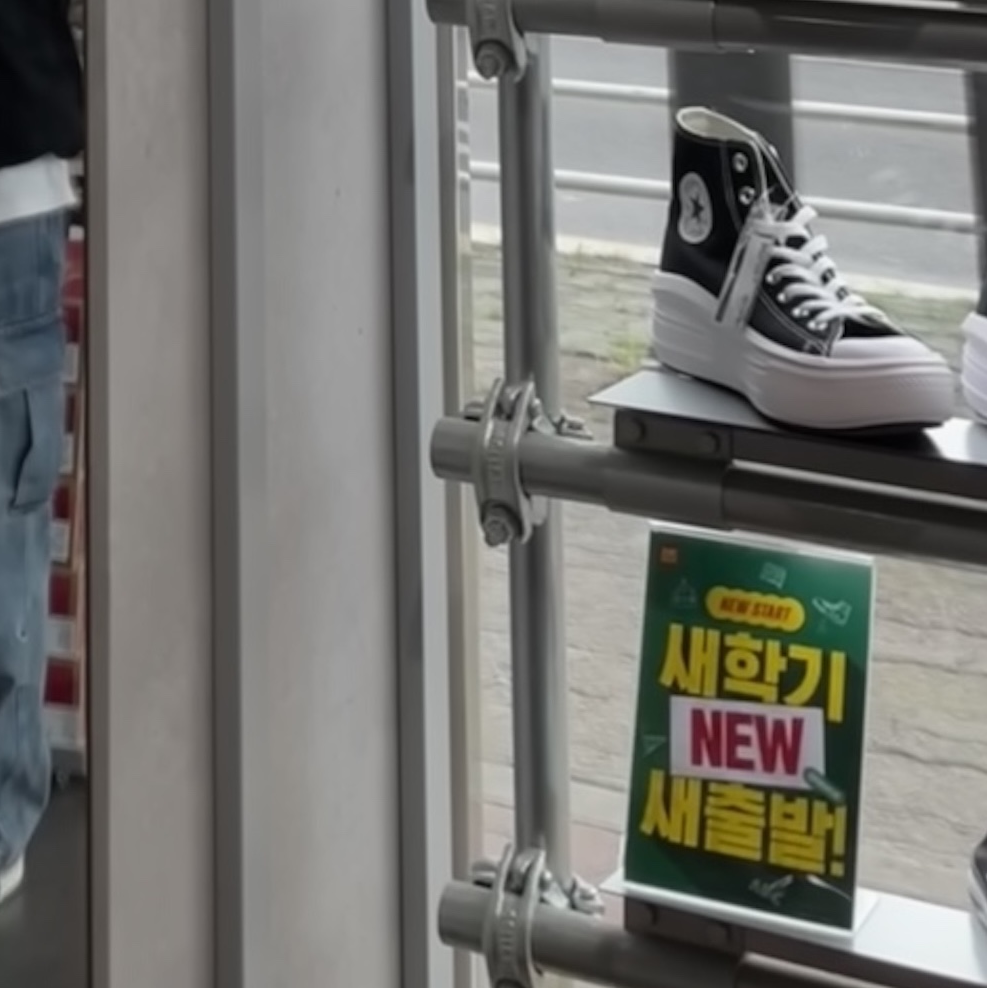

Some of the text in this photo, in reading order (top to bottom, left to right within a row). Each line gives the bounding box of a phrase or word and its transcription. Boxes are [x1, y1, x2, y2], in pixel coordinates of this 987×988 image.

[719, 596, 793, 622] NEW START
[659, 622, 847, 724] 새학기
[690, 707, 805, 777] NEW
[640, 768, 847, 877] 새출발!
